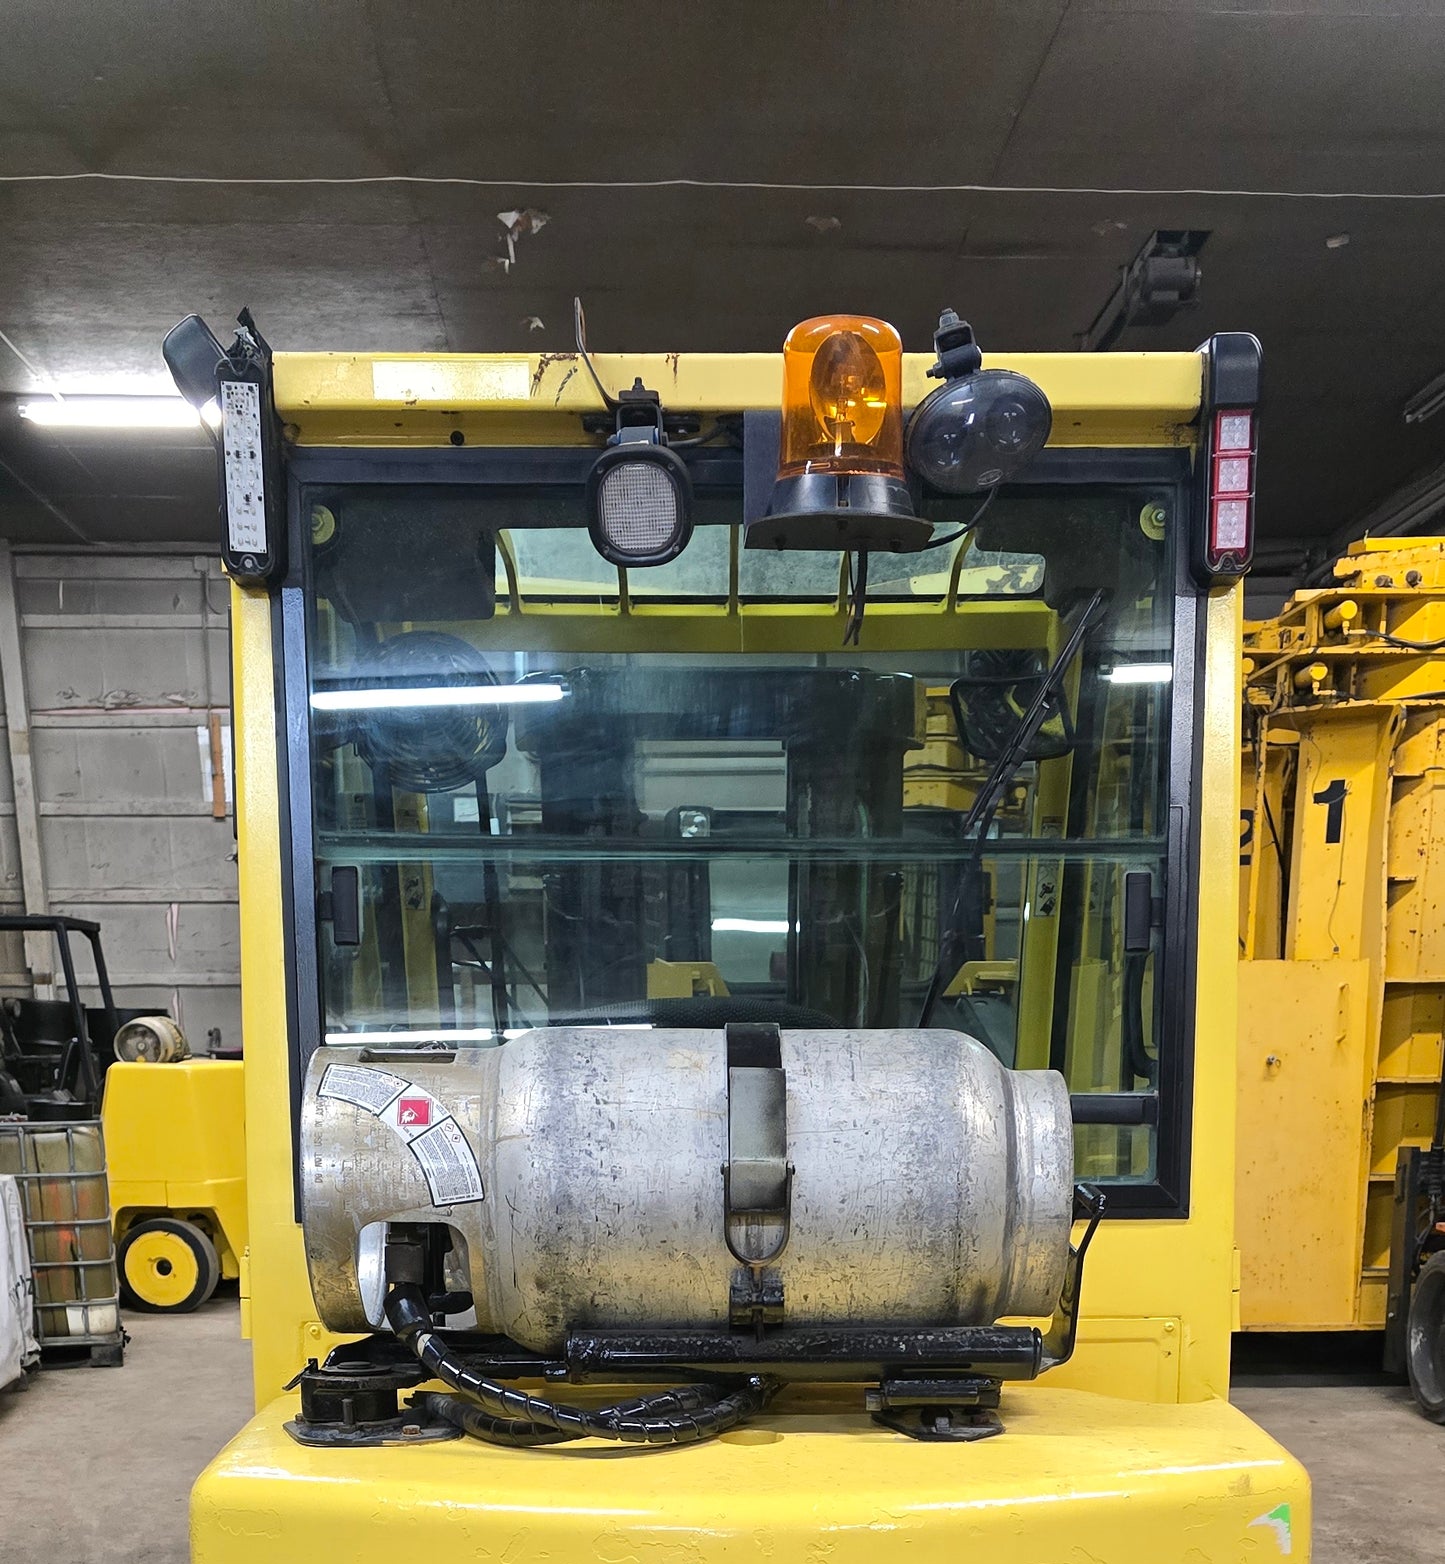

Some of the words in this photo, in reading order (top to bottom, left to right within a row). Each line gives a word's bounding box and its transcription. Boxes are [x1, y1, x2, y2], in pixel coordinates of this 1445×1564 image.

[1313, 779, 1346, 844] 1
[313, 1131, 322, 1147] USE
[314, 1173, 323, 1184] DO
